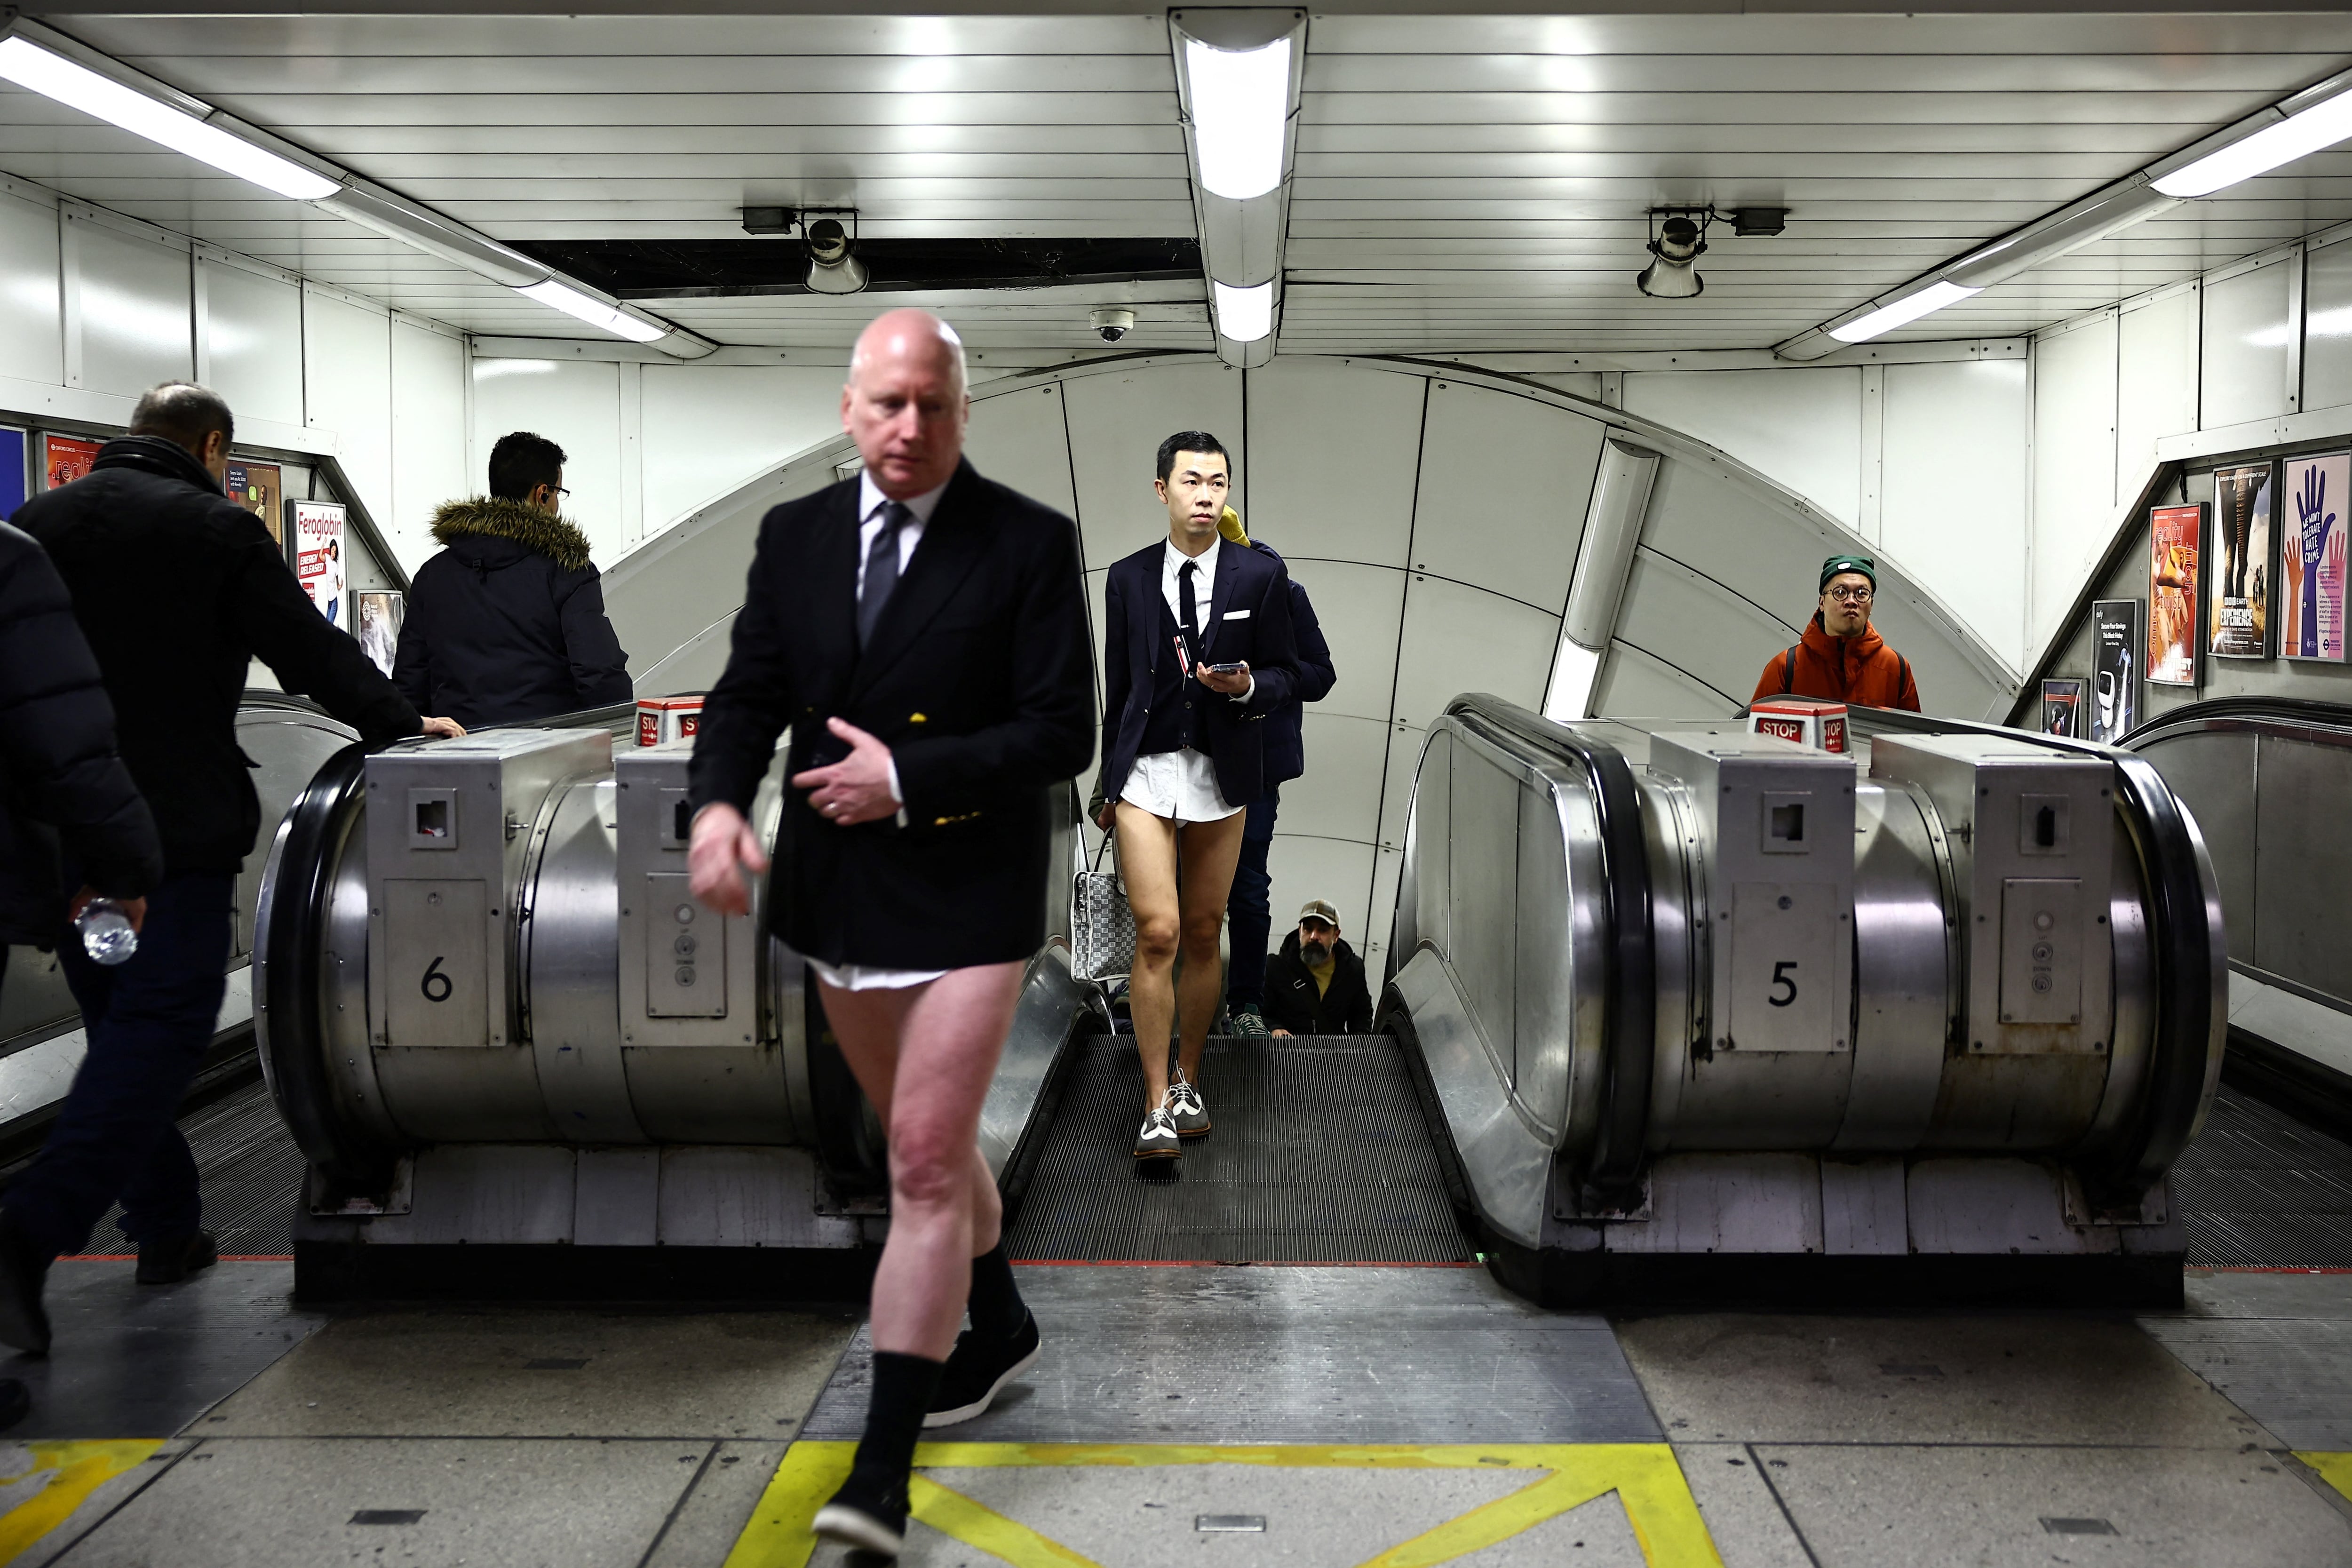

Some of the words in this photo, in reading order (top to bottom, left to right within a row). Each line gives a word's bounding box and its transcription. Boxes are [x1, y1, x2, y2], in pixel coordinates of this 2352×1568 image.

[299, 511, 342, 541] Feroglobin
[2303, 517, 2308, 529] WE
[2309, 511, 2320, 524] WON'T
[2302, 523, 2320, 541] TOLERATE
[2305, 535, 2318, 550] HATE
[300, 553, 318, 565] ENERGY
[2305, 549, 2319, 564] CRIME
[300, 563, 324, 576] RELEASED
[2160, 590, 2182, 610] twist
[2220, 608, 2253, 627] EXPERIENCE
[643, 716, 657, 730] STO
[1763, 722, 1797, 738] STOP
[1825, 723, 1841, 736] TOP
[421, 956, 452, 1002] 6
[1769, 962, 1797, 1007] 5
